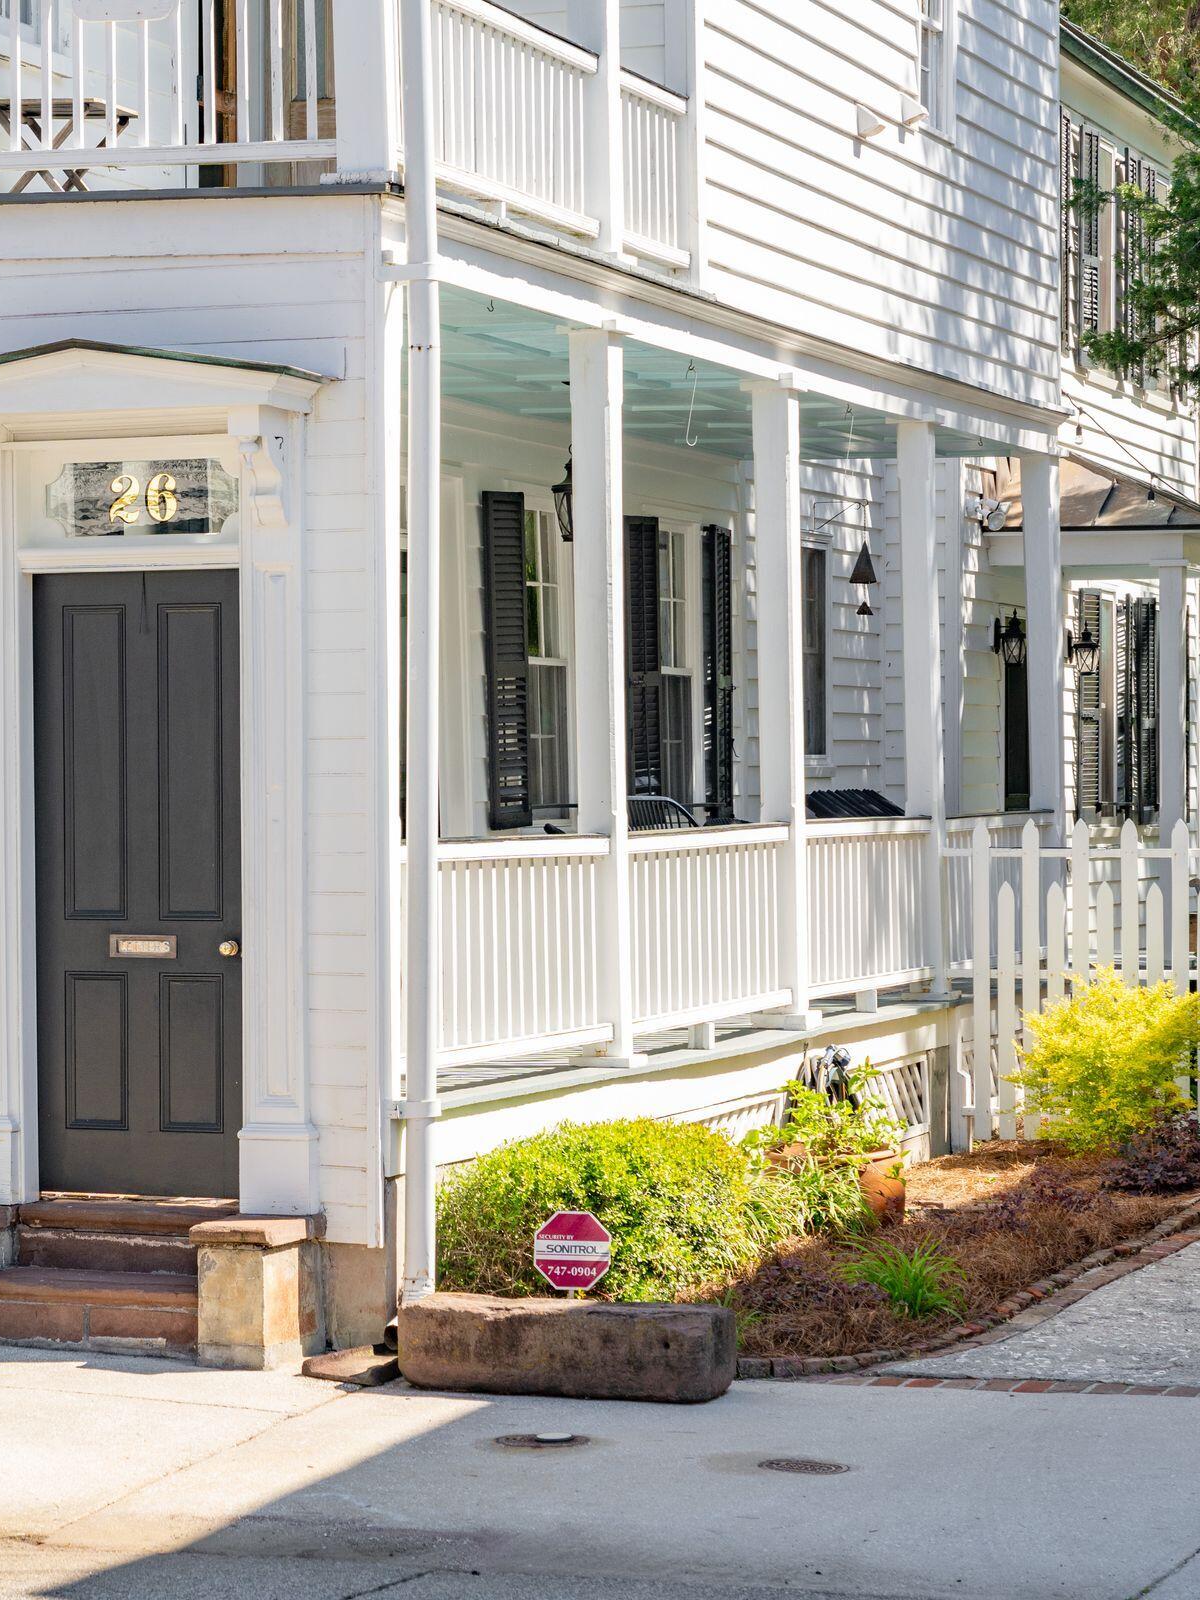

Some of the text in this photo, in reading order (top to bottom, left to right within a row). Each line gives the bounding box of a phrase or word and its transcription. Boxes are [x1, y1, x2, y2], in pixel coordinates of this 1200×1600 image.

[108, 473, 179, 524] 26
[546, 1244, 599, 1254] SONITROL
[547, 1265, 598, 1277] 747-0904
